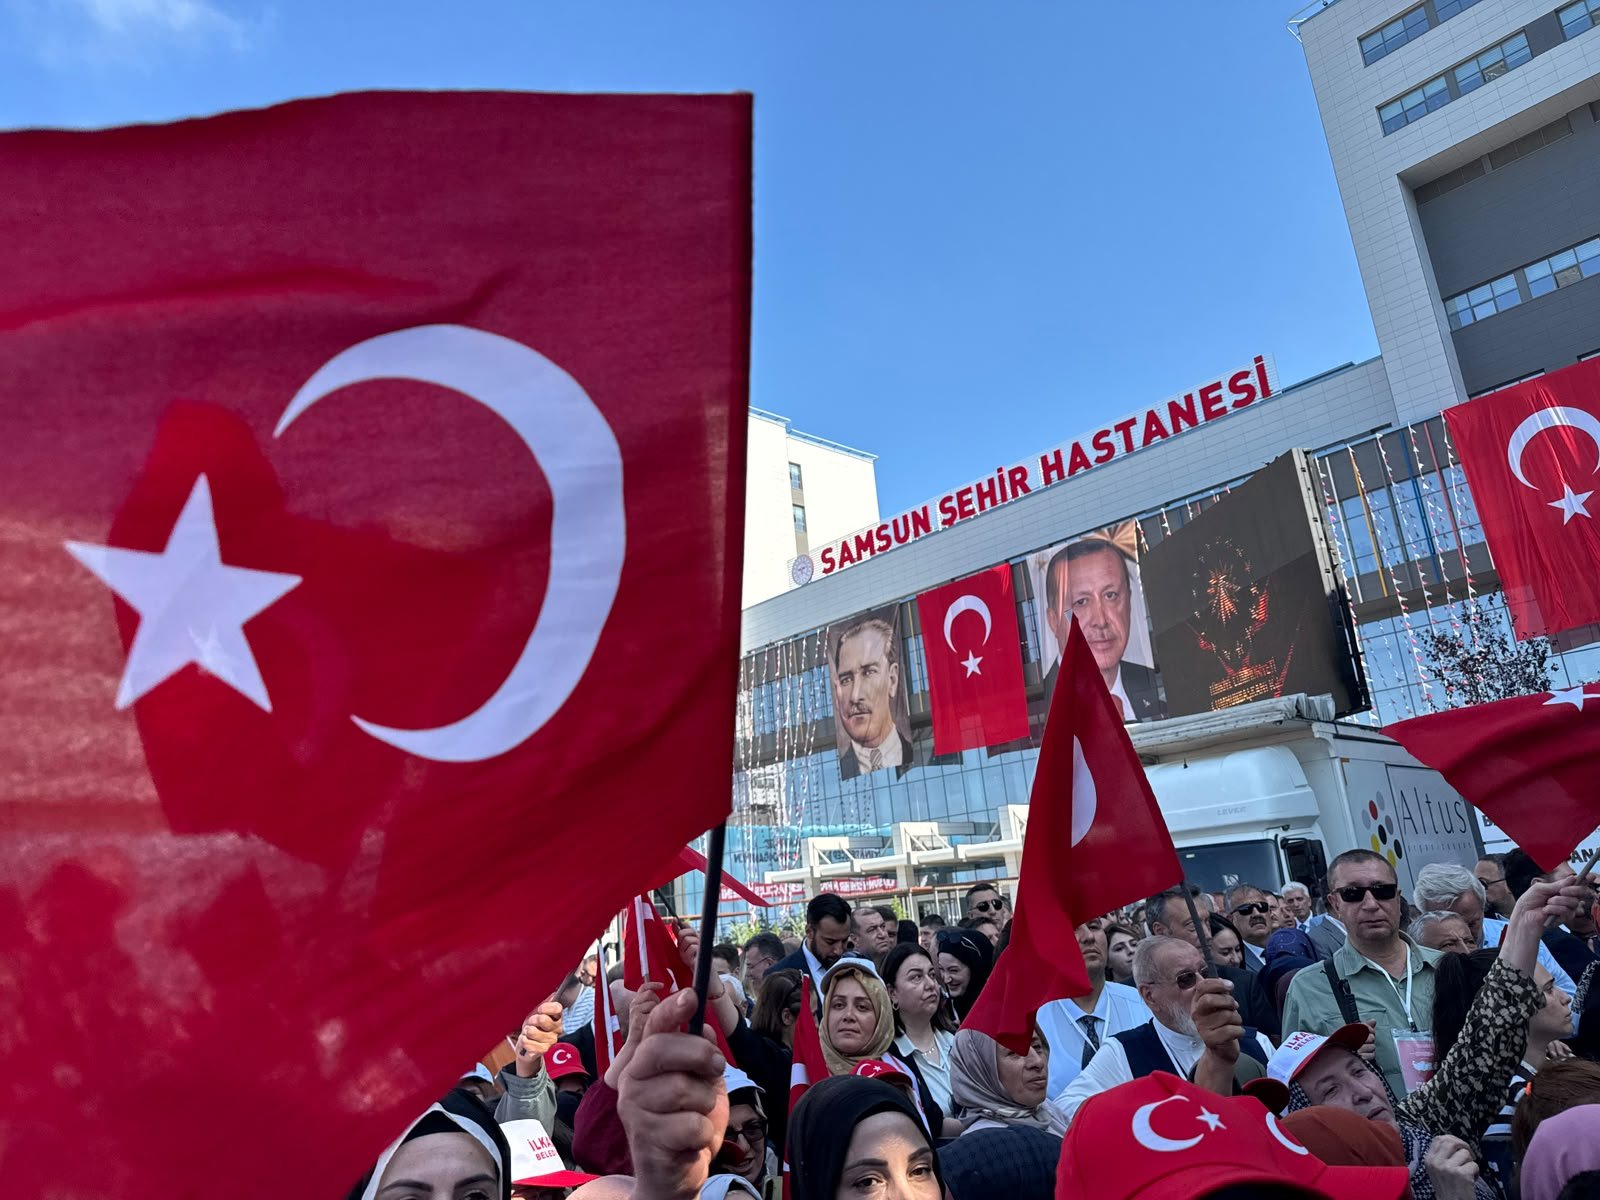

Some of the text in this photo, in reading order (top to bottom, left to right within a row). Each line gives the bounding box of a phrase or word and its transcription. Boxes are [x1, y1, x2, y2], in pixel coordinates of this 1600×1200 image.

[820, 506, 931, 575] SAMSUN
[938, 466, 1032, 529] ŞEHİR
[1040, 355, 1272, 486] HASTANESİ
[1400, 787, 1467, 835] Altus
